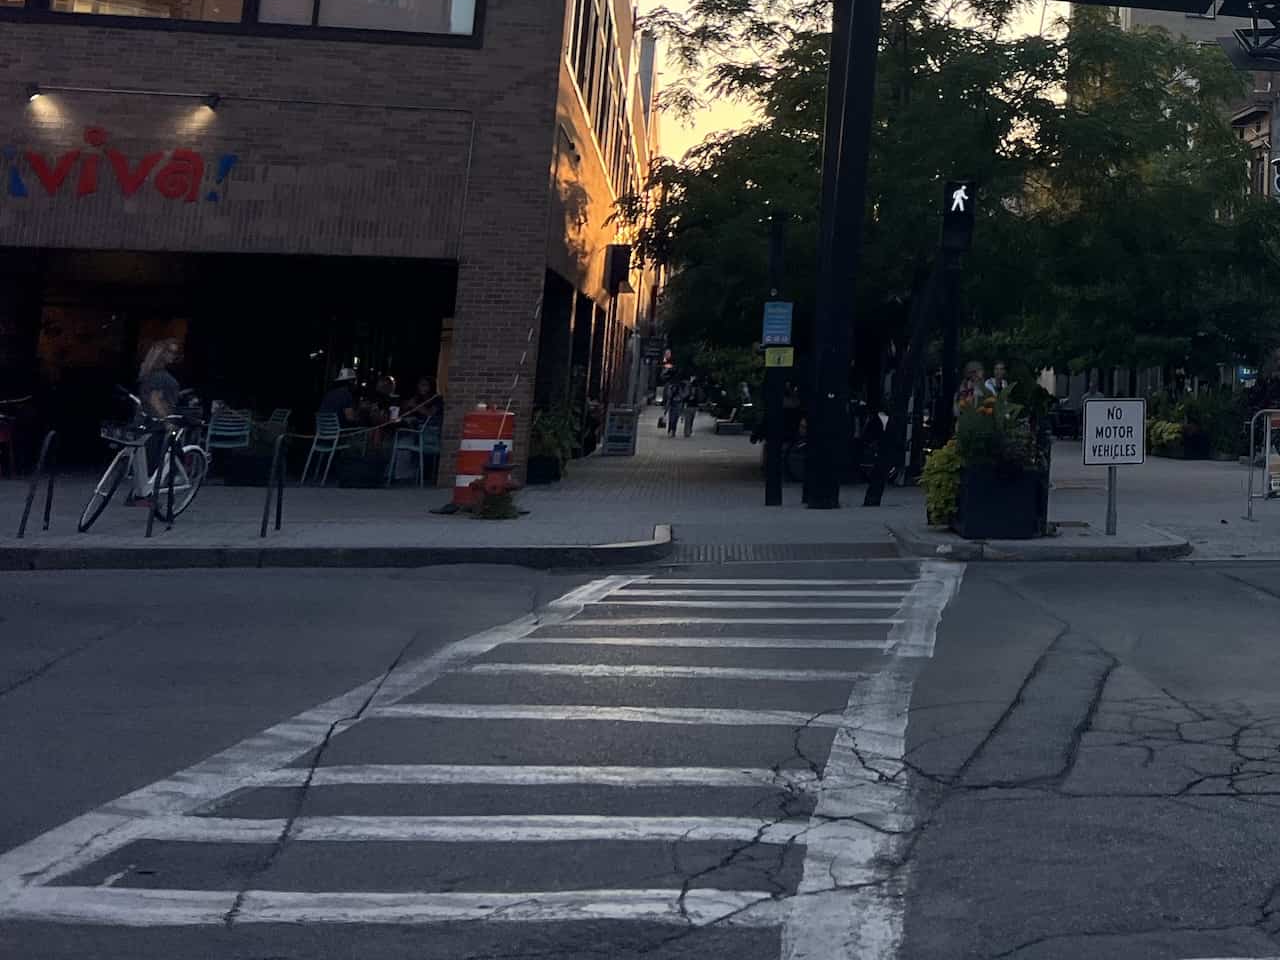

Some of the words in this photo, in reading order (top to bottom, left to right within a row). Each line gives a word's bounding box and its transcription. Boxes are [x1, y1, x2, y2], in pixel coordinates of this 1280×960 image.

[1107, 406, 1122, 420] NO
[1096, 426, 1133, 439] MOTOR
[1092, 444, 1136, 457] VEHICLES
